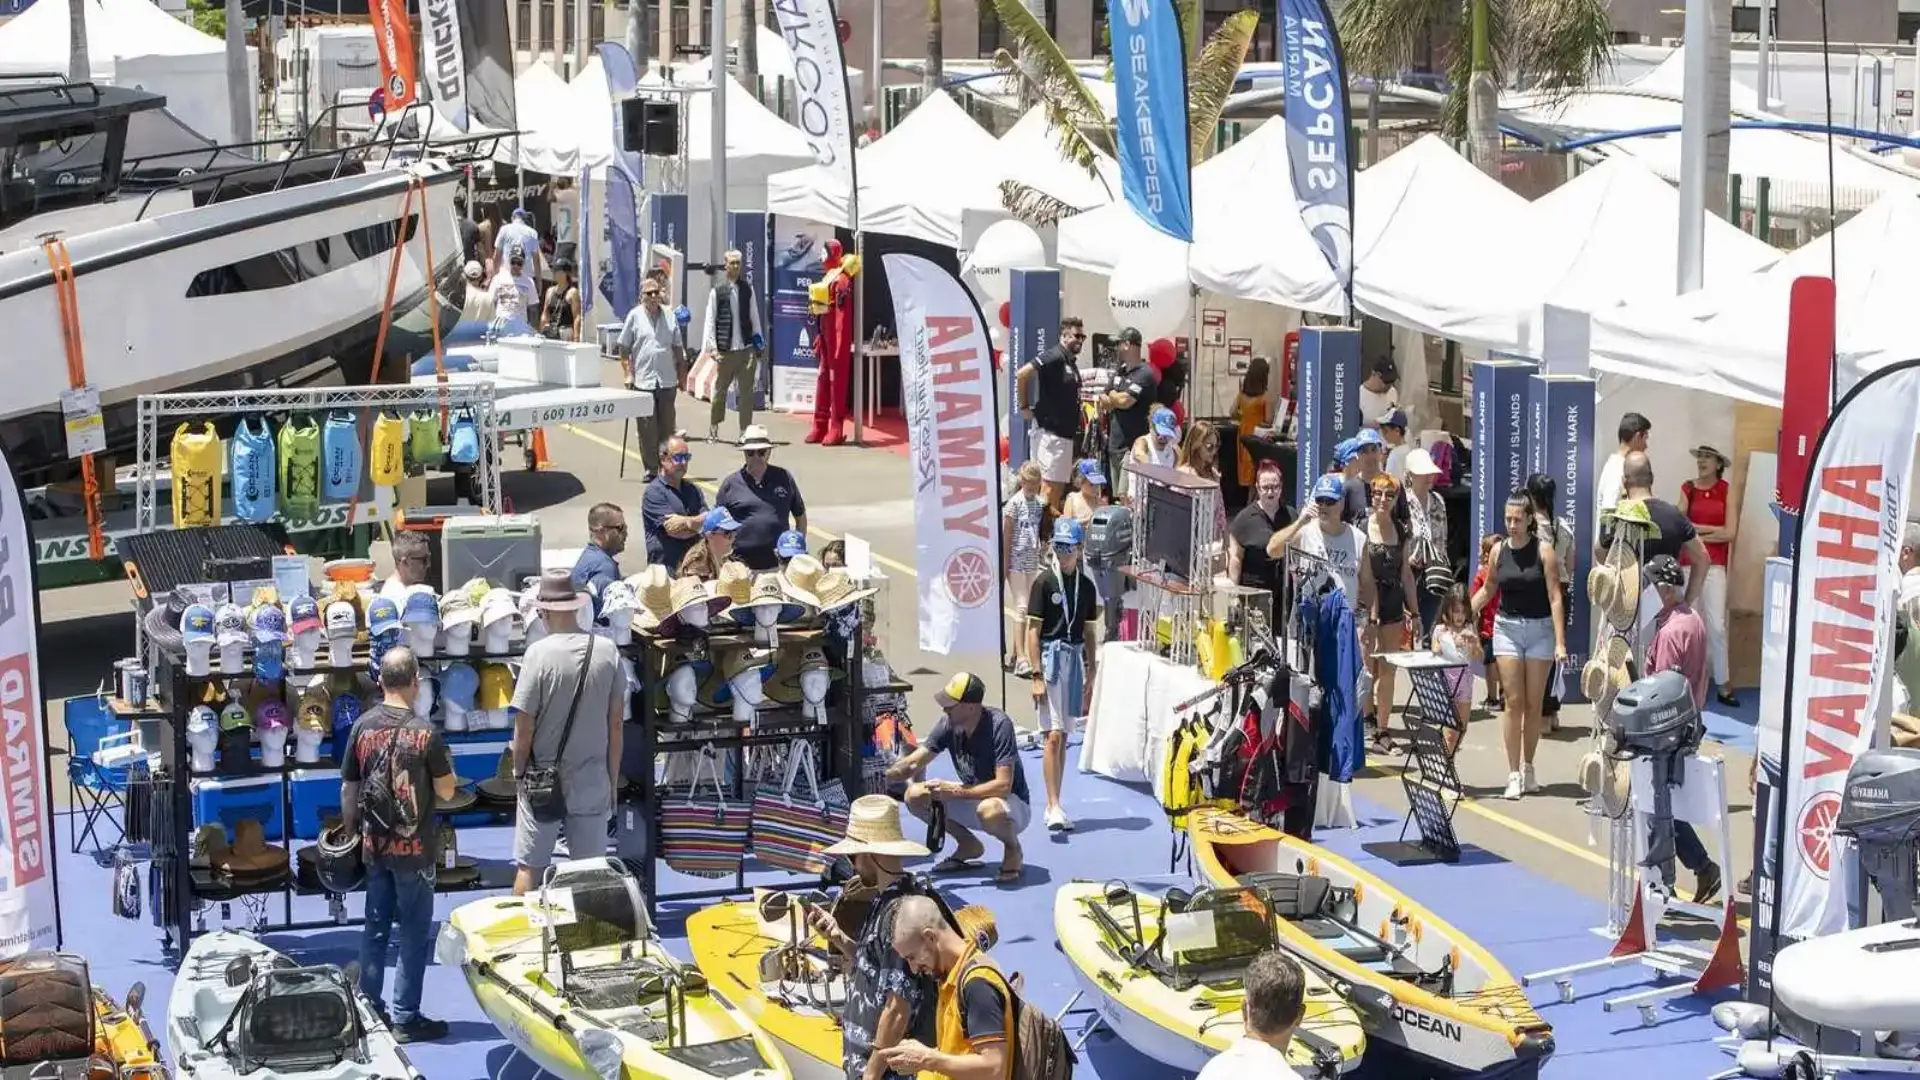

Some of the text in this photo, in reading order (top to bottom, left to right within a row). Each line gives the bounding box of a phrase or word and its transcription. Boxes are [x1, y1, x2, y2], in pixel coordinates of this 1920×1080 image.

[1129, 33, 1163, 214] SEAKEEPER
[1037, 328, 1046, 357] RIAS
[543, 403, 615, 421] 609 123 410
[1334, 362, 1345, 431] SEAKEEPER
[1510, 393, 1521, 448] ISLANDS
[1567, 404, 1579, 442] MARK
[1304, 440, 1312, 485] MARINA
[1566, 446, 1578, 496] GLOBAL
[1882, 475, 1900, 555] Heart
[1803, 464, 1884, 780] YAMAHA
[1859, 786, 1890, 800] YAMAHA
[1390, 1005, 1462, 1043] OCEAN
